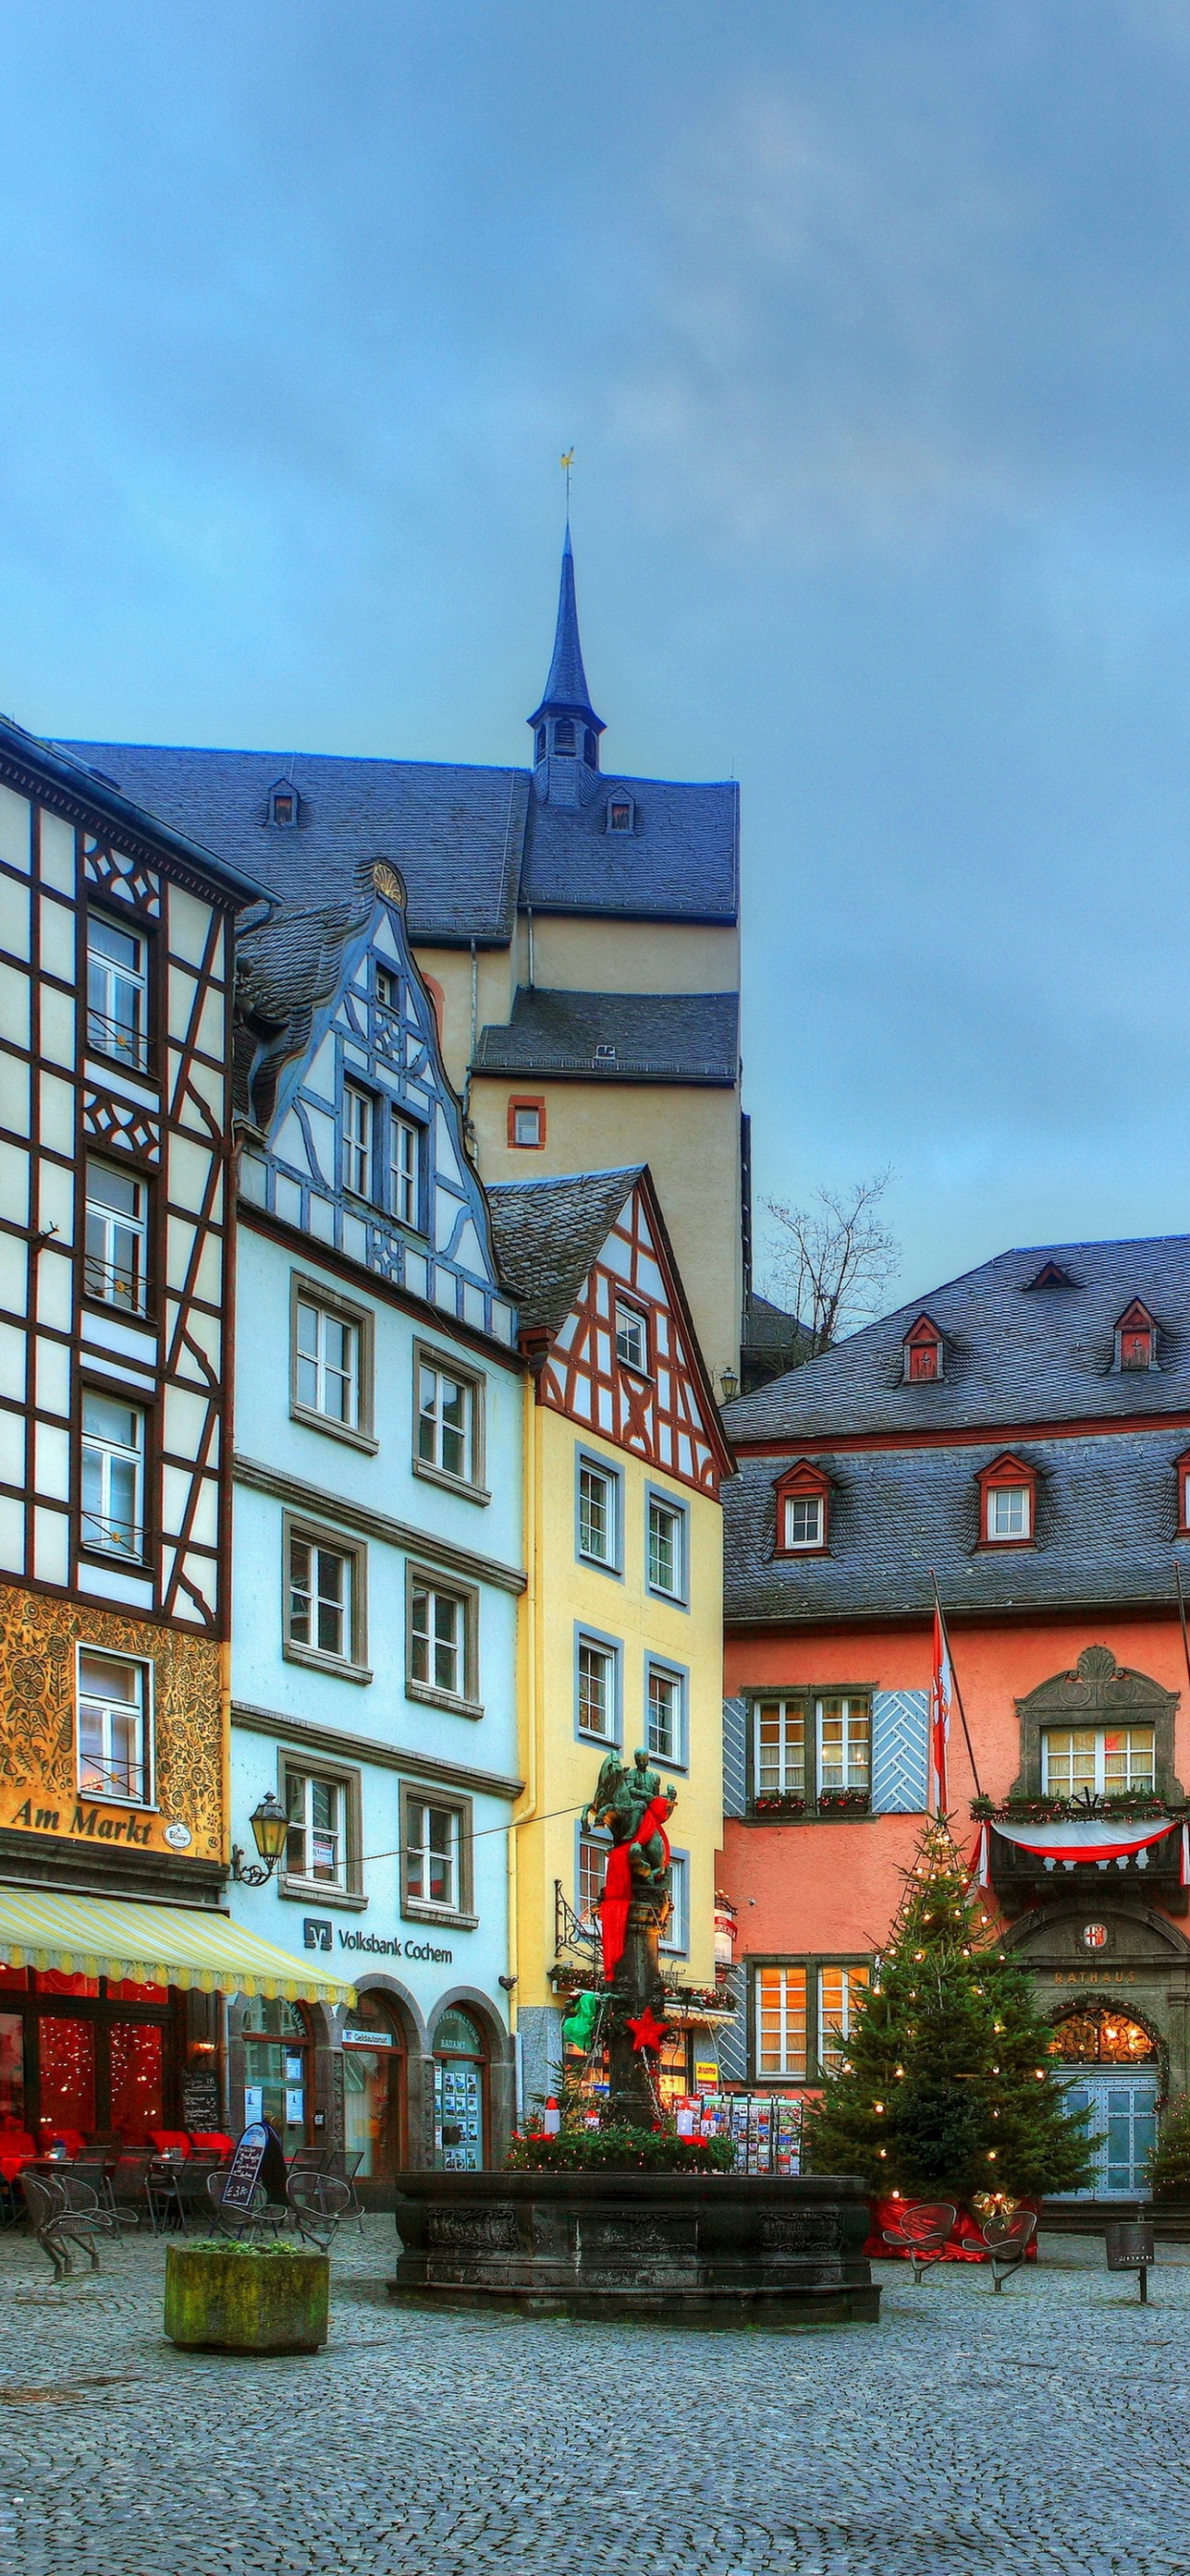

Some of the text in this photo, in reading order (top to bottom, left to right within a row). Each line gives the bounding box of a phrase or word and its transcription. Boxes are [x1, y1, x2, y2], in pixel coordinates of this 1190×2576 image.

[11, 1798, 153, 1845] Am Markt
[338, 1929, 453, 1965] Volksbank Cochem
[1054, 1971, 1137, 1985] RATHAUS
[355, 2034, 388, 2043] Geldautomat
[441, 2039, 467, 2050] BAUAMT
